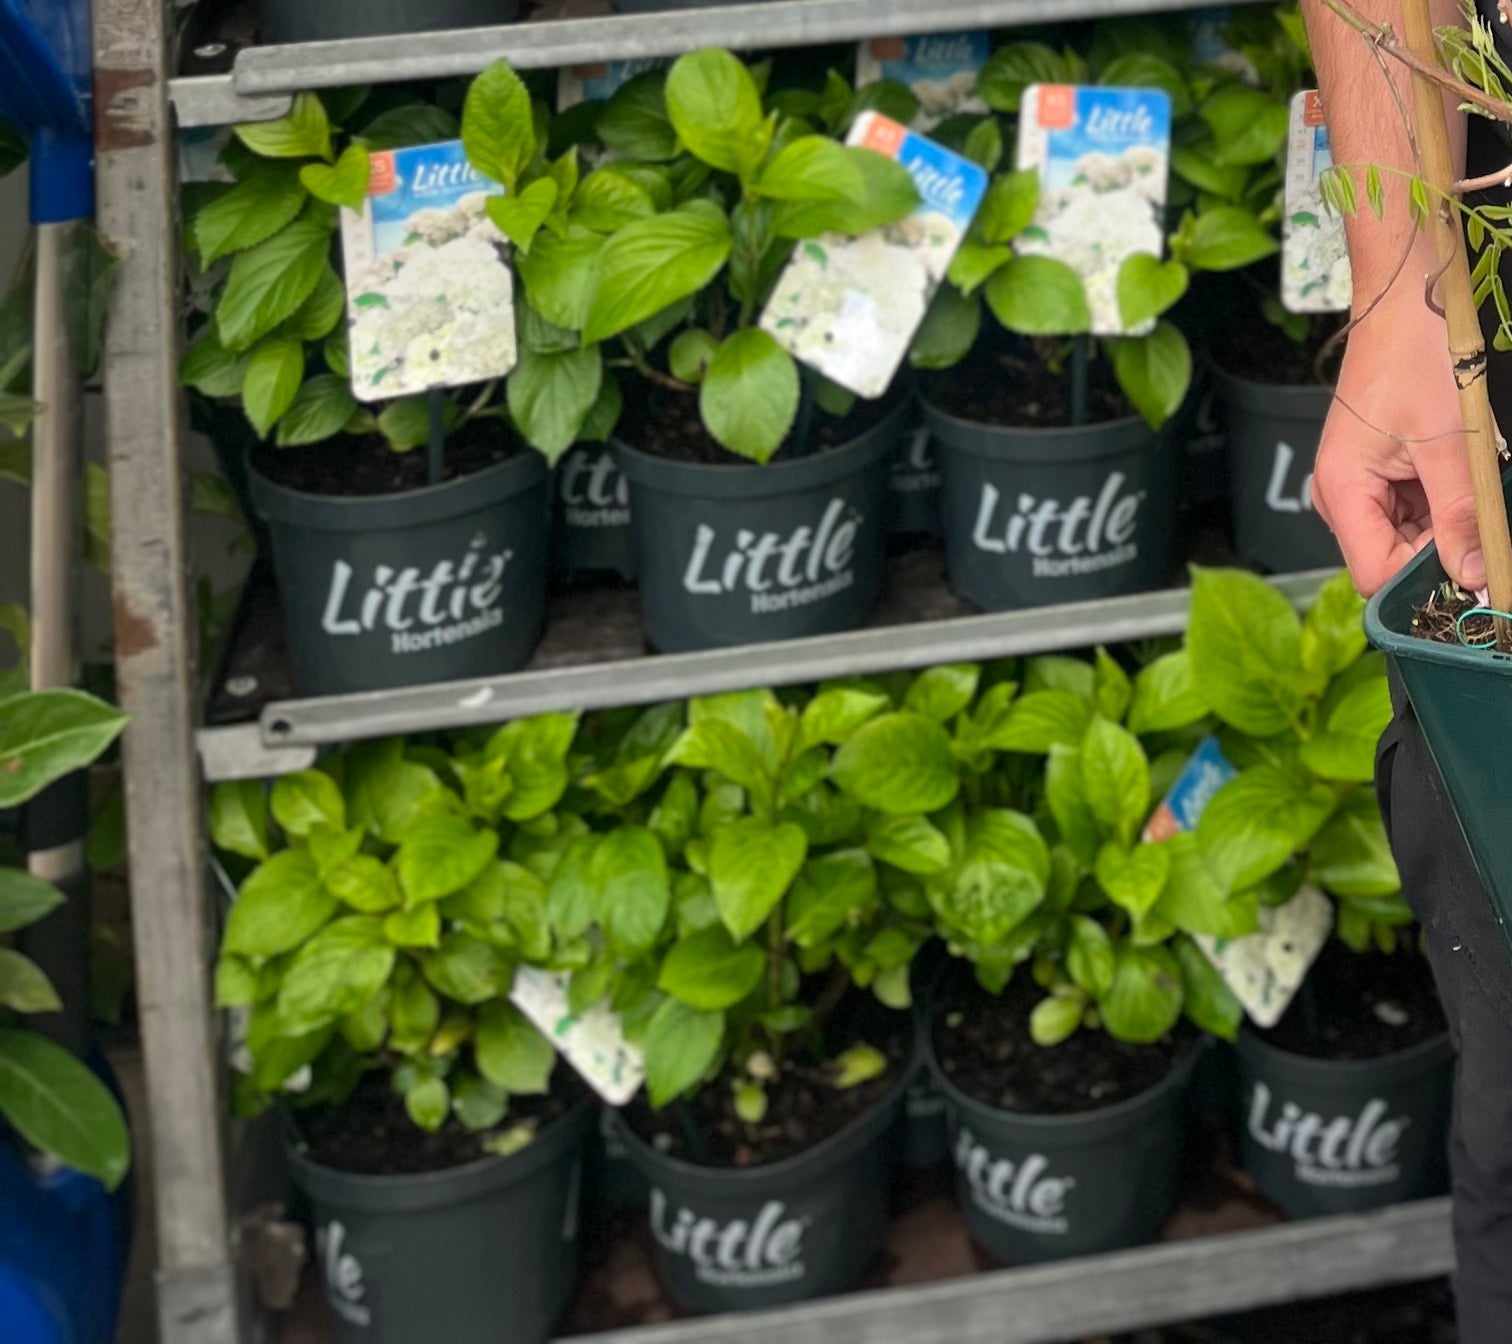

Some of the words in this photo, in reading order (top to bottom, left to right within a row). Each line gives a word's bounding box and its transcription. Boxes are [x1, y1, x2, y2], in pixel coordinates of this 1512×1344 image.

[1085, 106, 1153, 135] Little
[906, 156, 966, 202] Little
[973, 470, 1139, 556] Little
[683, 497, 857, 595] Little
[751, 568, 855, 613] Hortensia
[390, 608, 504, 654] Hortensia
[1247, 1079, 1400, 1169] Little
[649, 1186, 803, 1269] Little
